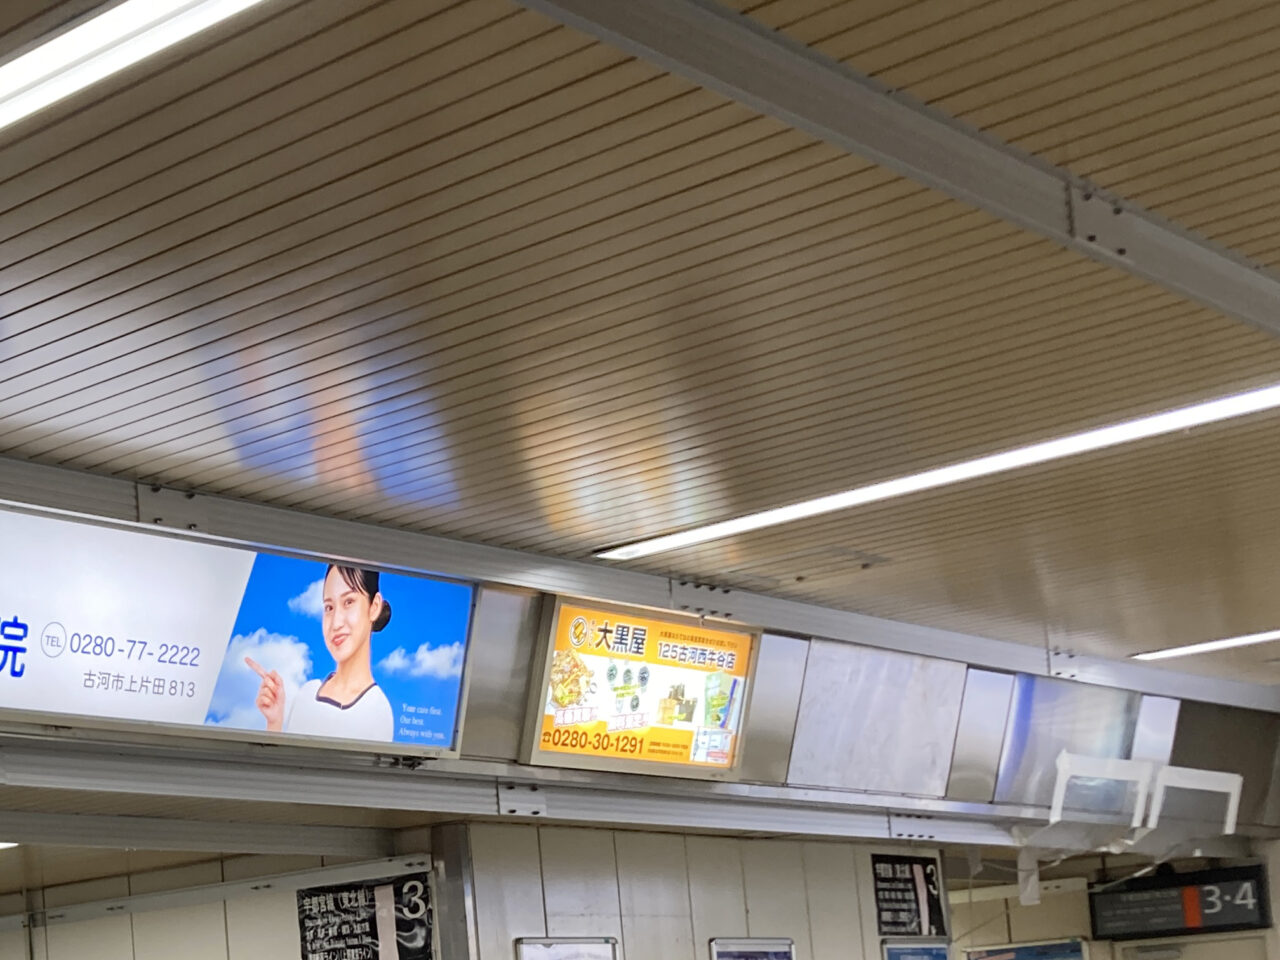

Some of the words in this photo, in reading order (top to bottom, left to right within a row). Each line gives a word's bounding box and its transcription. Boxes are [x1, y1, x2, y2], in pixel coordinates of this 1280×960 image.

[45, 635, 62, 648] TEL
[70, 633, 200, 667] 0280-77-2222
[595, 622, 647, 656] 大黒屋
[658, 642, 737, 670] 125古河西牛谷店
[552, 729, 644, 754] 0280-30-1291
[926, 864, 939, 896] 3
[402, 880, 426, 919] 3
